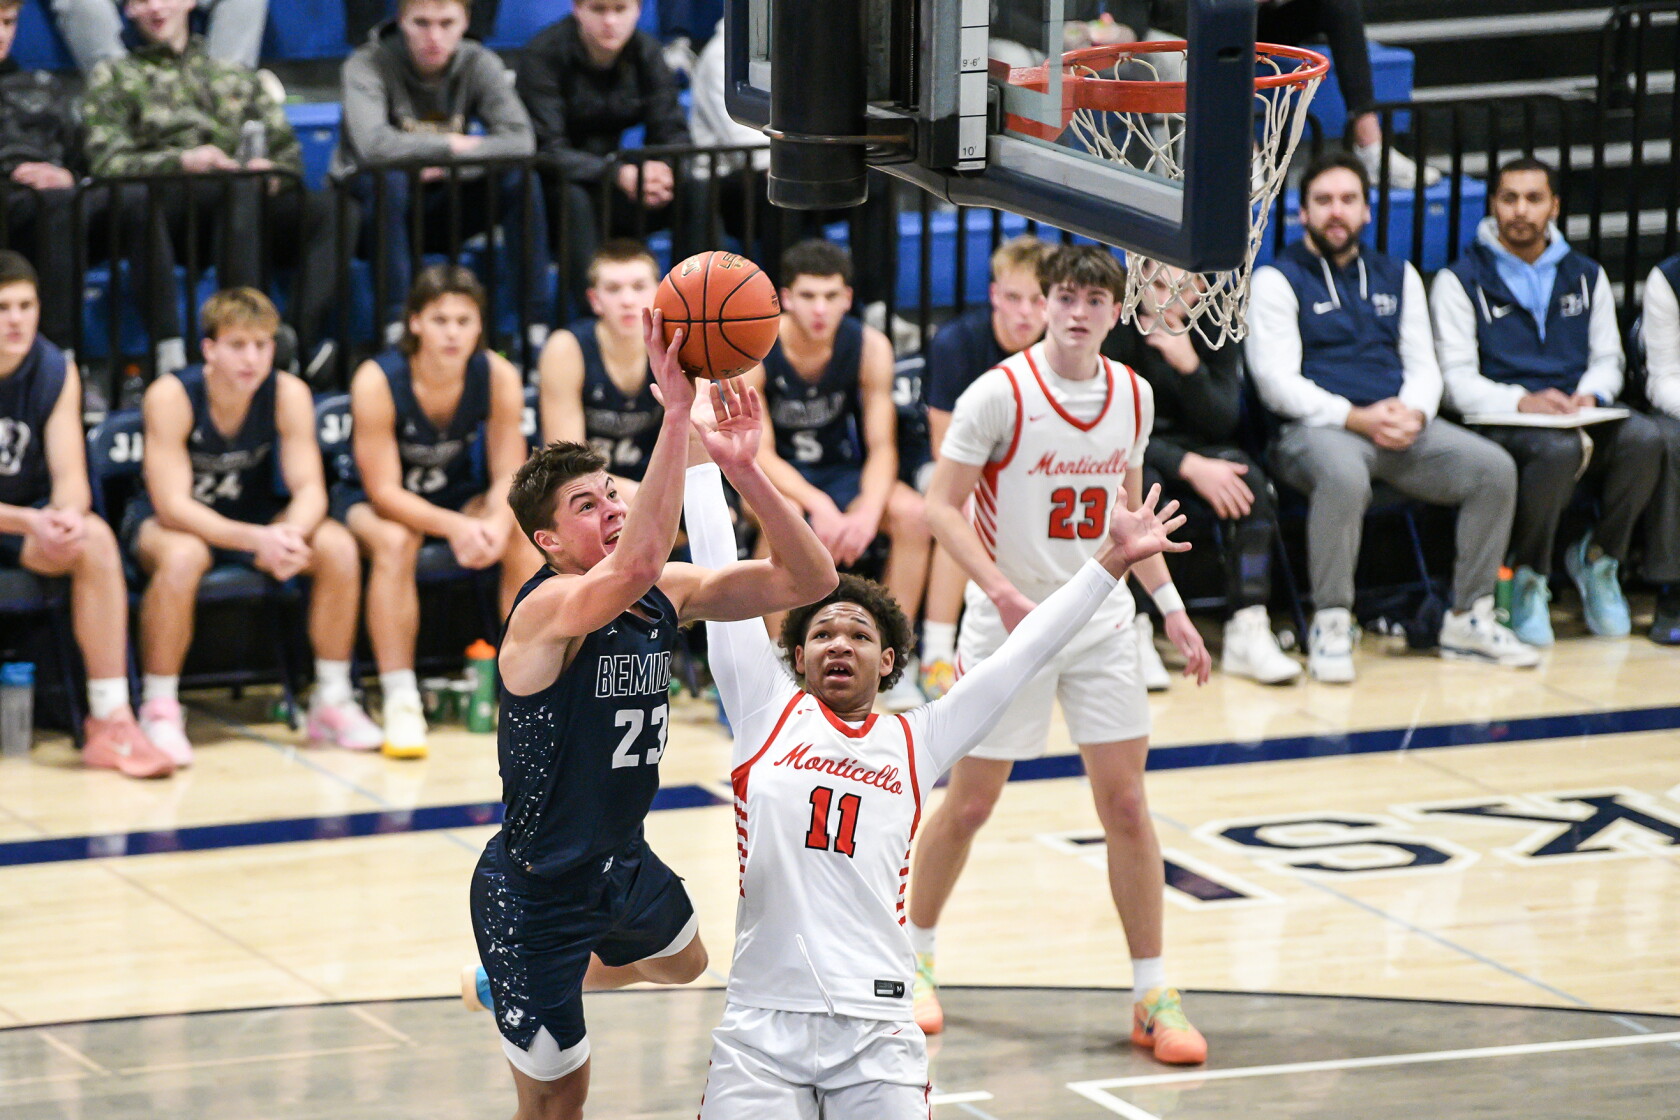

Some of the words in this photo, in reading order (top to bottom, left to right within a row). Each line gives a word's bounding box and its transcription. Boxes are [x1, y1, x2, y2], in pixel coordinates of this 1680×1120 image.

[1048, 486, 1108, 539] 23
[612, 703, 667, 769] 23
[773, 741, 903, 795] Monticello
[805, 785, 862, 858] 11
